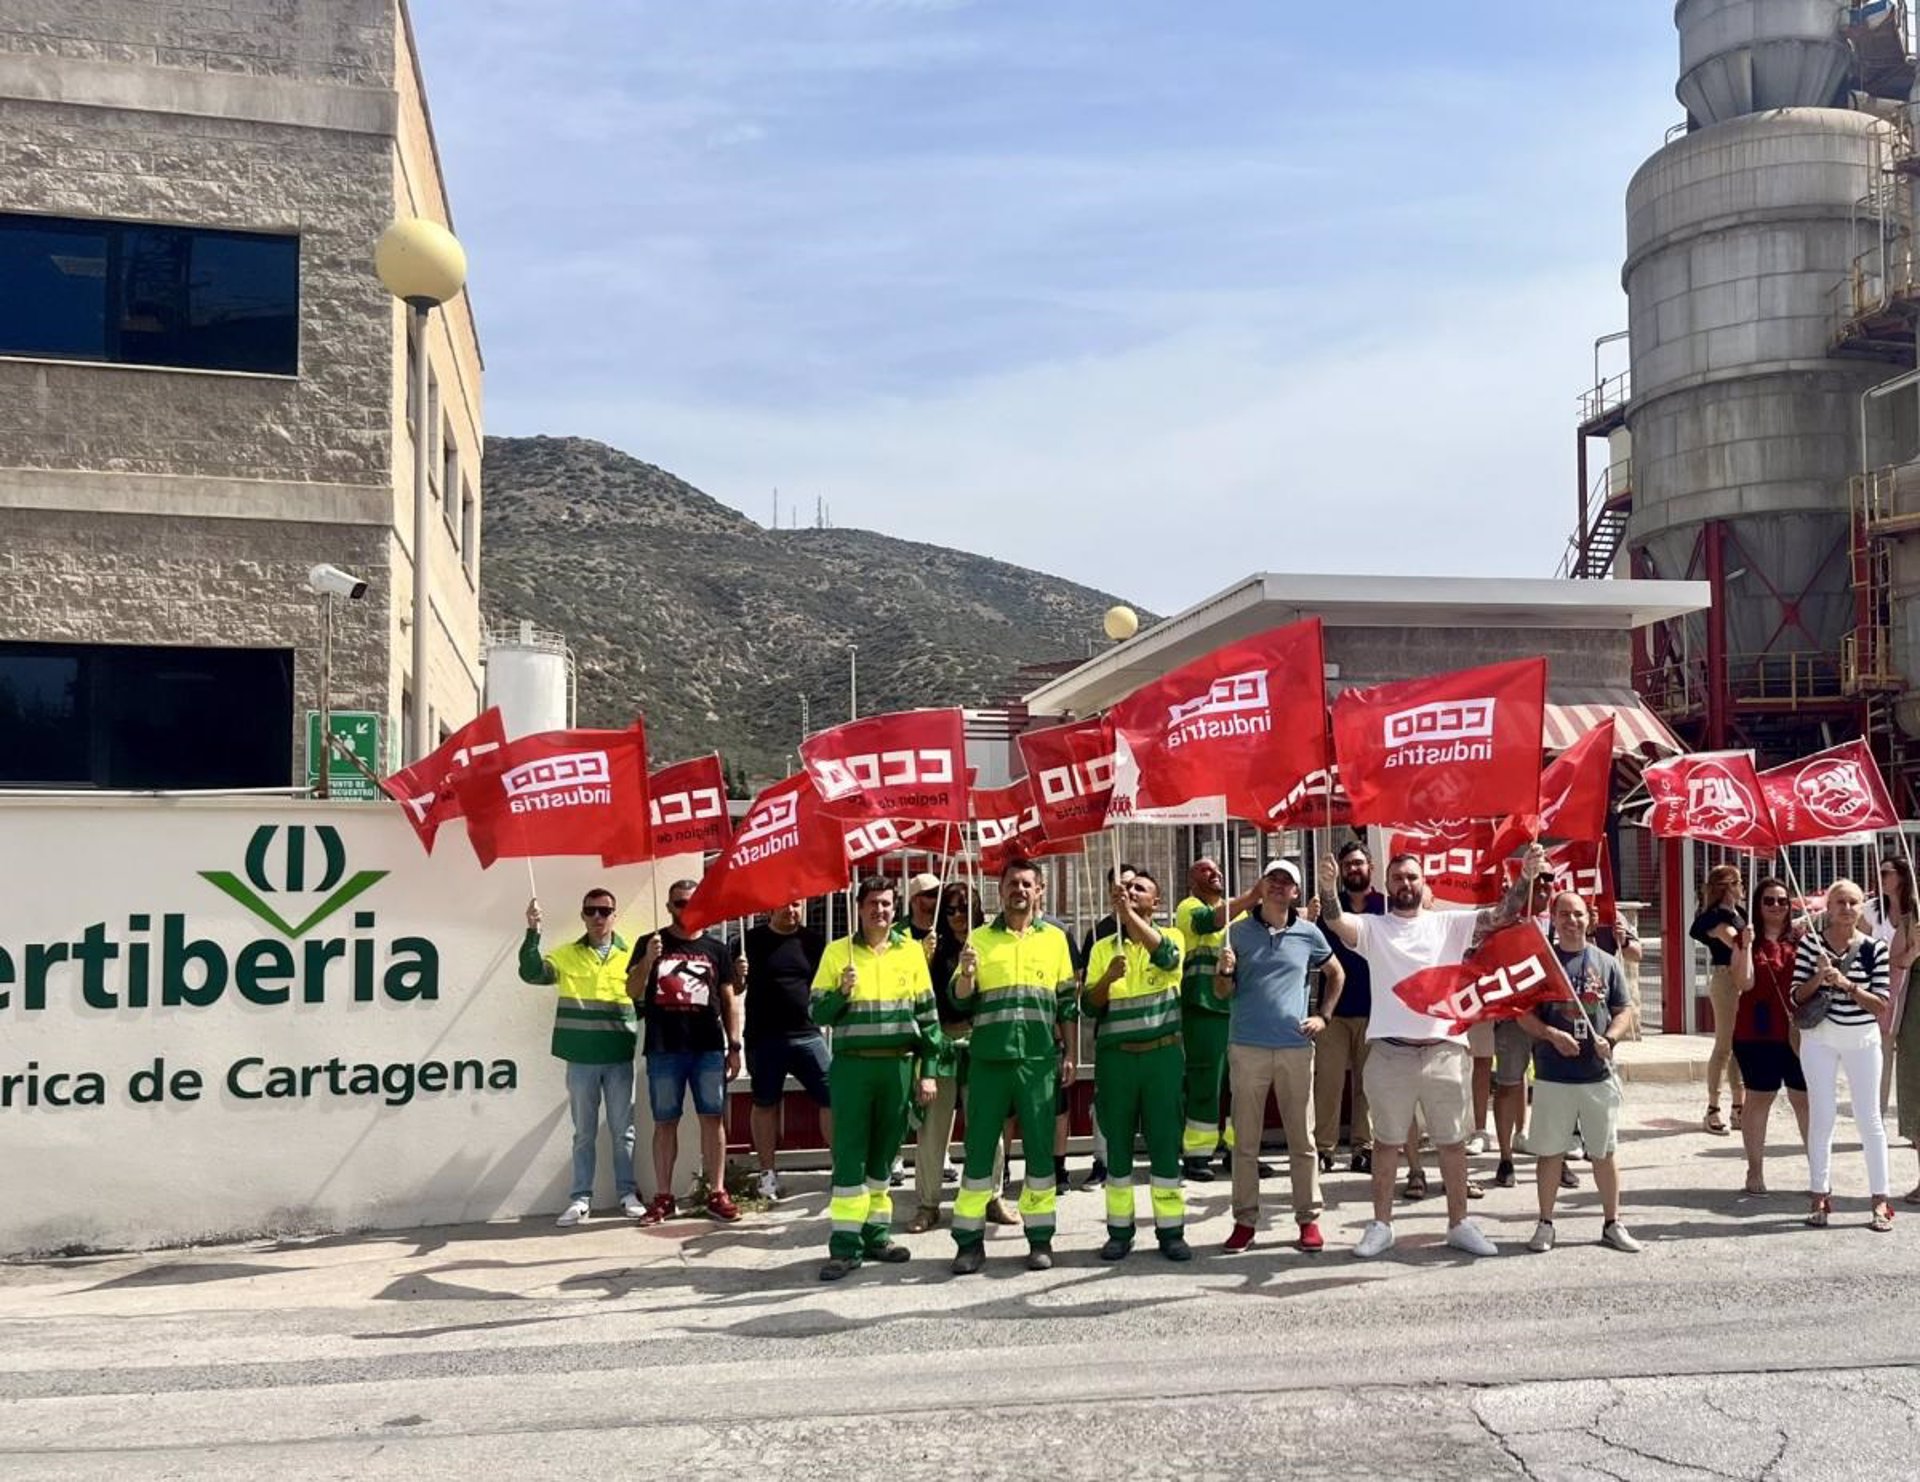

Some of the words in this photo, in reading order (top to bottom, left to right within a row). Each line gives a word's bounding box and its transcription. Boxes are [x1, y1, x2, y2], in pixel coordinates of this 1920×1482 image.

[0, 911, 439, 1011] rtiberia
[128, 1057, 203, 1103] de
[226, 1056, 518, 1106] Cartagena
